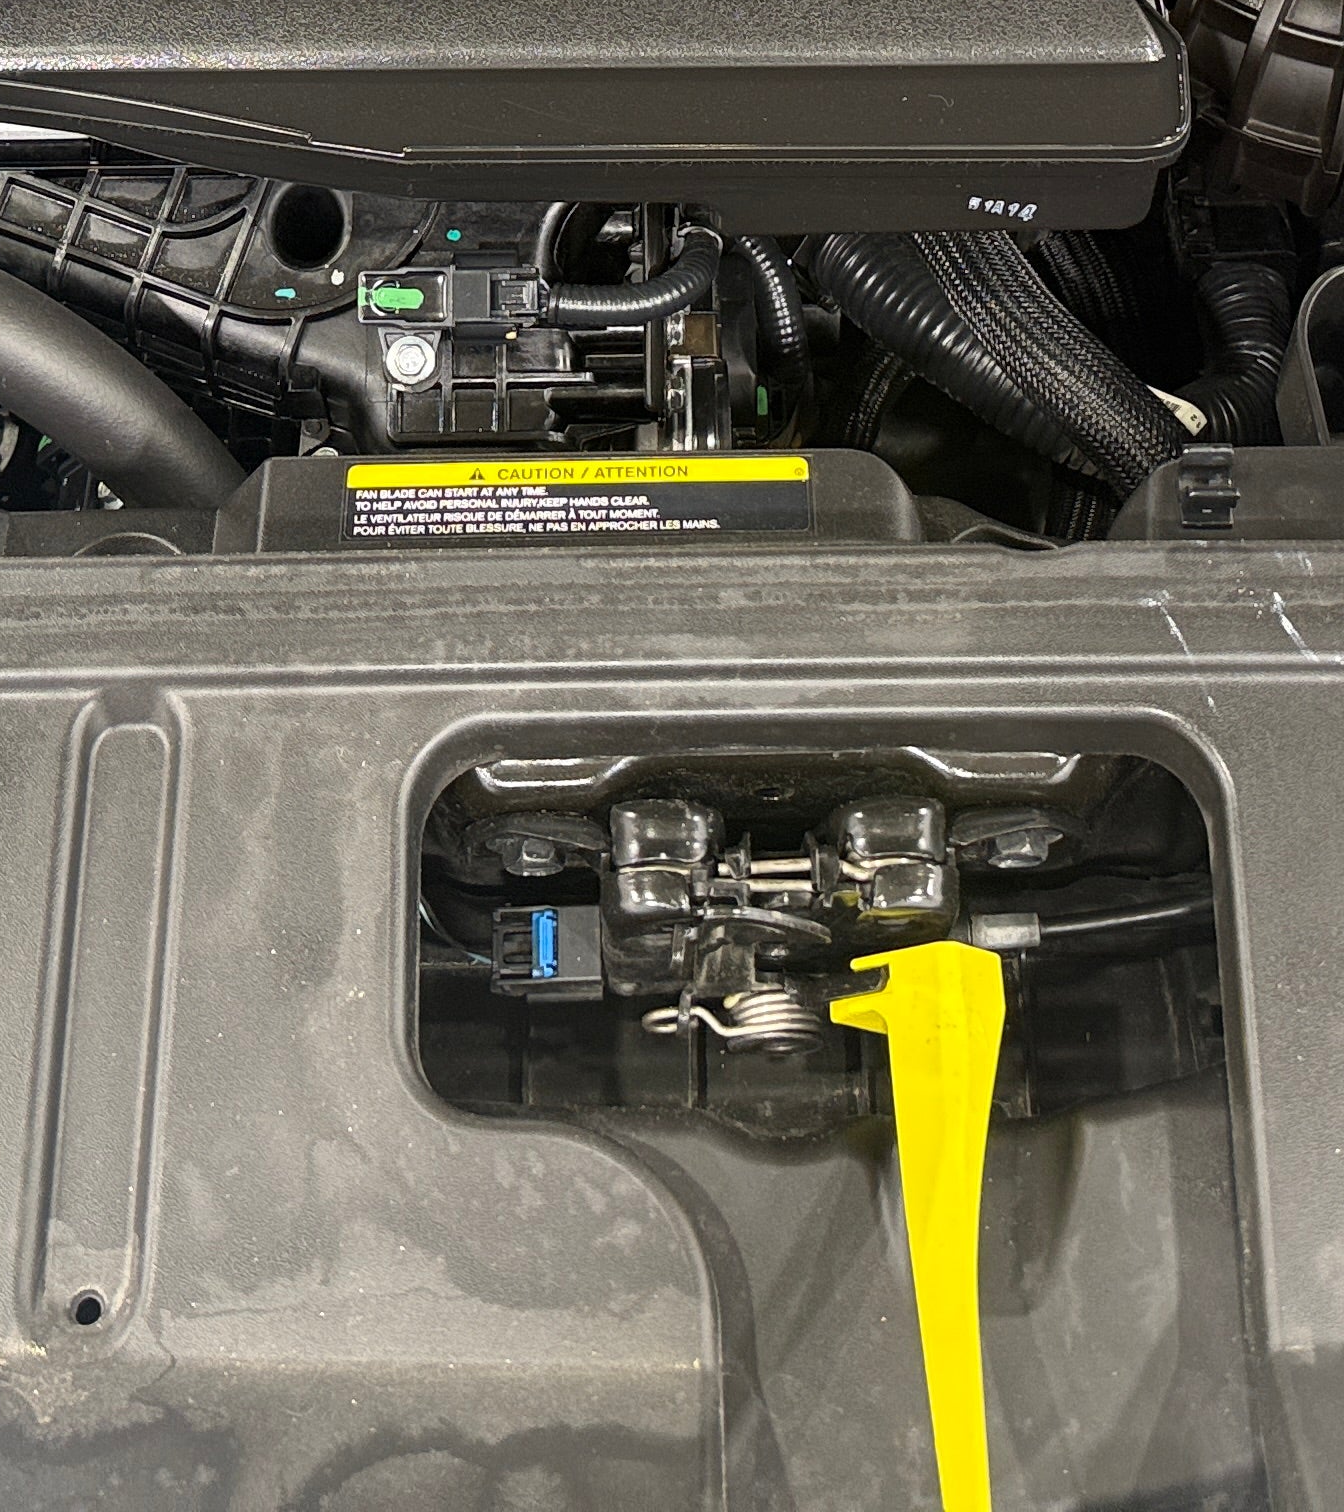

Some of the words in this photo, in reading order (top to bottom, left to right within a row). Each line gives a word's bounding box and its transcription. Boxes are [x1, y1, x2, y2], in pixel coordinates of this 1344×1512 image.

[497, 467, 575, 481] CAUTION
[594, 465, 689, 478] ATTENTION
[356, 489, 377, 500] FAN
[379, 489, 416, 500] BLADE
[417, 488, 443, 499] CAN
[444, 487, 480, 498] START
[480, 487, 495, 497] AT
[496, 486, 519, 497] ANY
[520, 485, 548, 497] TIME.
[355, 501, 371, 512] TO
[372, 500, 402, 511] HELP
[402, 499, 438, 510] AVOID
[439, 498, 499, 510] PERSONAL
[570, 496, 609, 507] HANDS
[610, 495, 650, 506] CLEAR.
[353, 514, 368, 524] LE
[370, 512, 442, 524] VENTILATEUR
[443, 511, 485, 523] RISQUE
[486, 510, 503, 522] DE
[504, 508, 566, 521] DÉMARRER
[578, 509, 607, 520] TOUT
[609, 508, 661, 519] MOMENT.
[352, 525, 386, 536] POUR
[387, 522, 425, 535] ÉVITER
[428, 524, 464, 535] TOUTE
[465, 523, 527, 534] BLESSURE,
[528, 522, 544, 533] NE
[546, 521, 569, 532] PAS
[570, 521, 587, 532] EN
[588, 520, 658, 531] APPROCHER
[659, 519, 681, 530] LES
[682, 518, 721, 530] MAINS.
